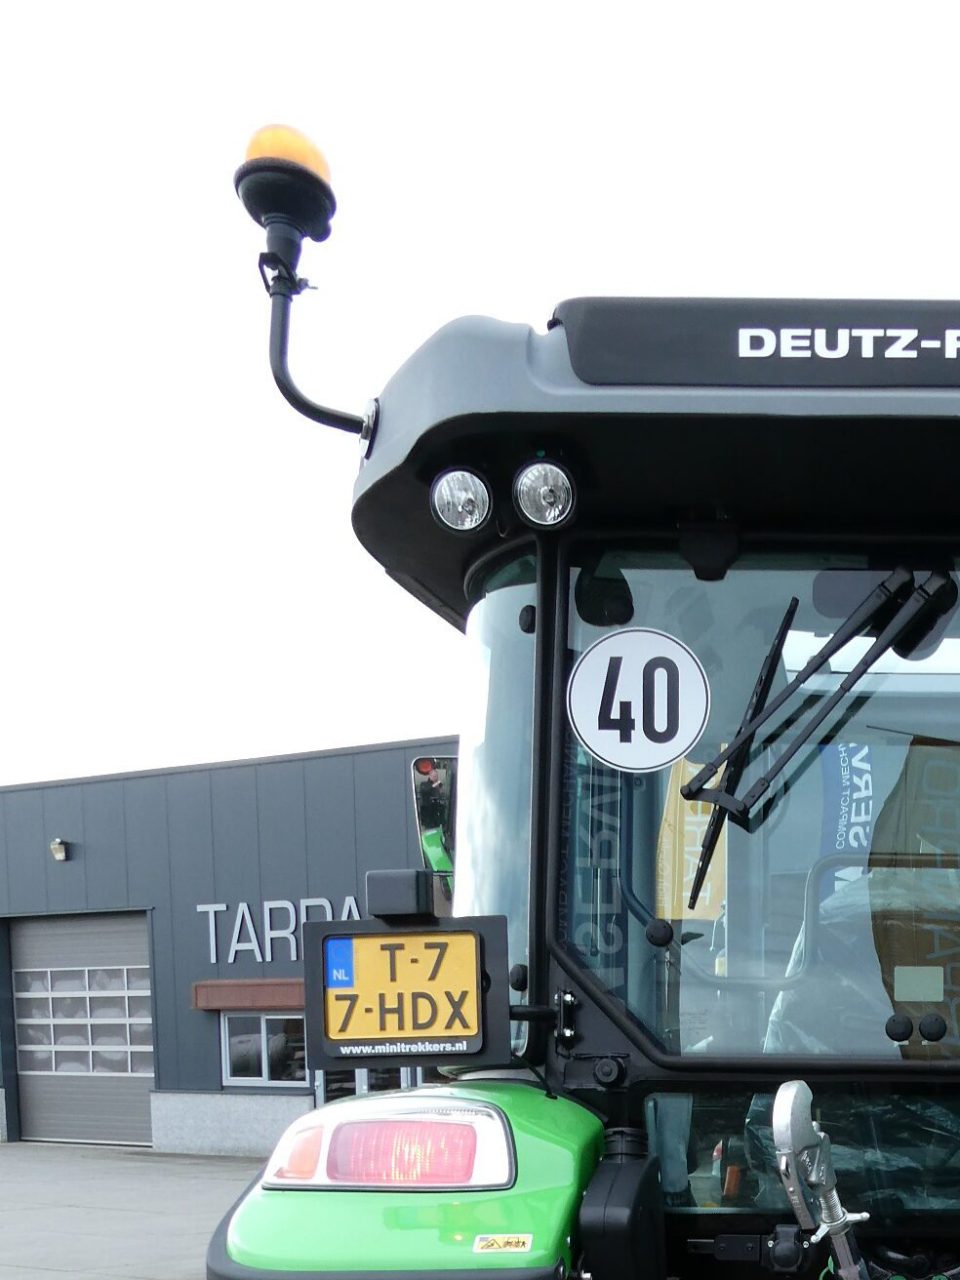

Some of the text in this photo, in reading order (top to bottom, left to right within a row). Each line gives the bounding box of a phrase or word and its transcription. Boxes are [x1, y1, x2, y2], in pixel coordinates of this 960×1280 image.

[597, 655, 680, 744] 40
[333, 968, 350, 981] NL
[379, 941, 449, 983] T-7
[334, 990, 470, 1034] 7-HDX
[340, 1040, 468, 1055] www.minitrekkers.nl
